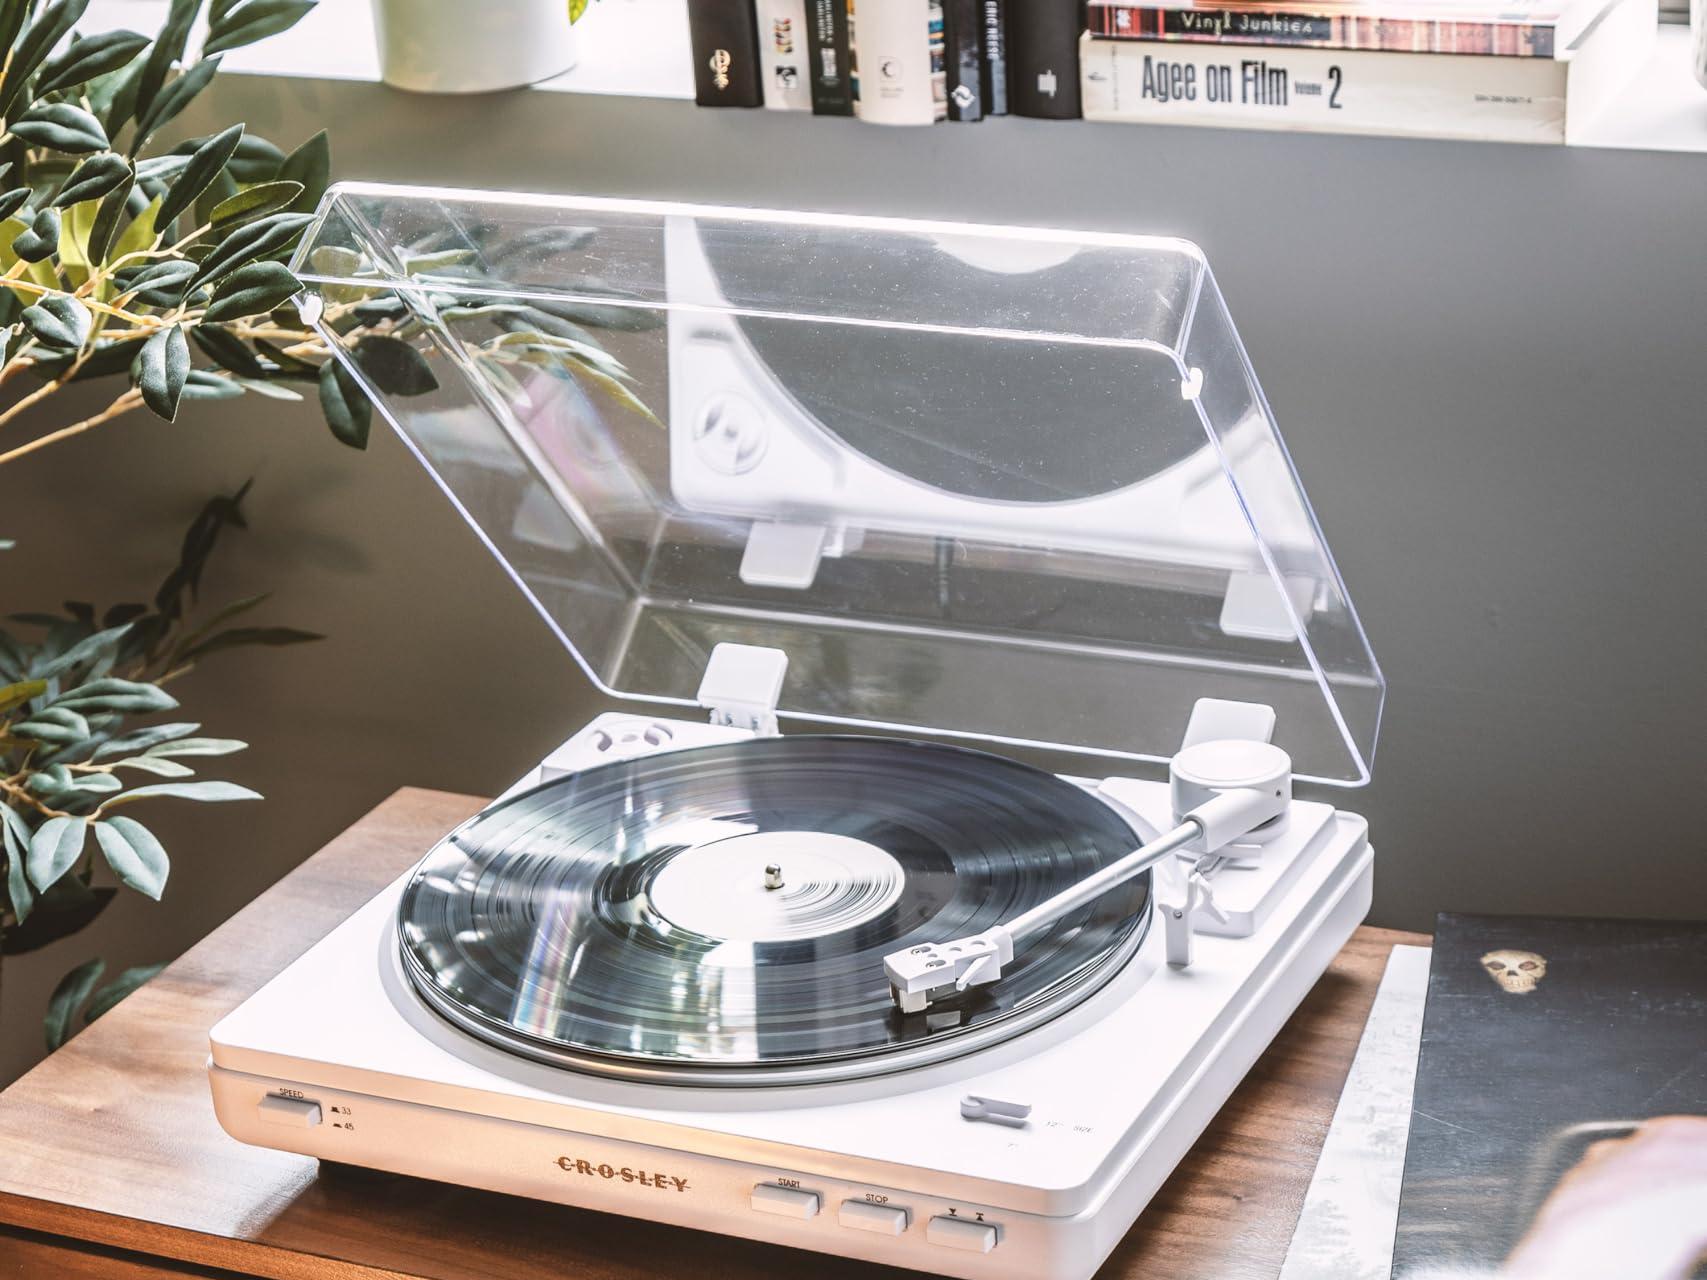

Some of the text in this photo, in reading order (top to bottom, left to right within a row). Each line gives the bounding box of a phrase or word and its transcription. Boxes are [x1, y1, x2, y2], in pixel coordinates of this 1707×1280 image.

[1182, 11, 1312, 36] Vinyl Junkies
[1142, 55, 1196, 102] Agee
[1207, 65, 1232, 102] on
[1242, 60, 1288, 105] Film
[1328, 65, 1342, 109] 2
[280, 1088, 304, 1099] SPEED
[342, 1107, 352, 1116] 33
[344, 1123, 355, 1131] 45
[553, 1156, 691, 1192] CROSLEY
[778, 1178, 800, 1189] START
[866, 1193, 888, 1204] STOP
